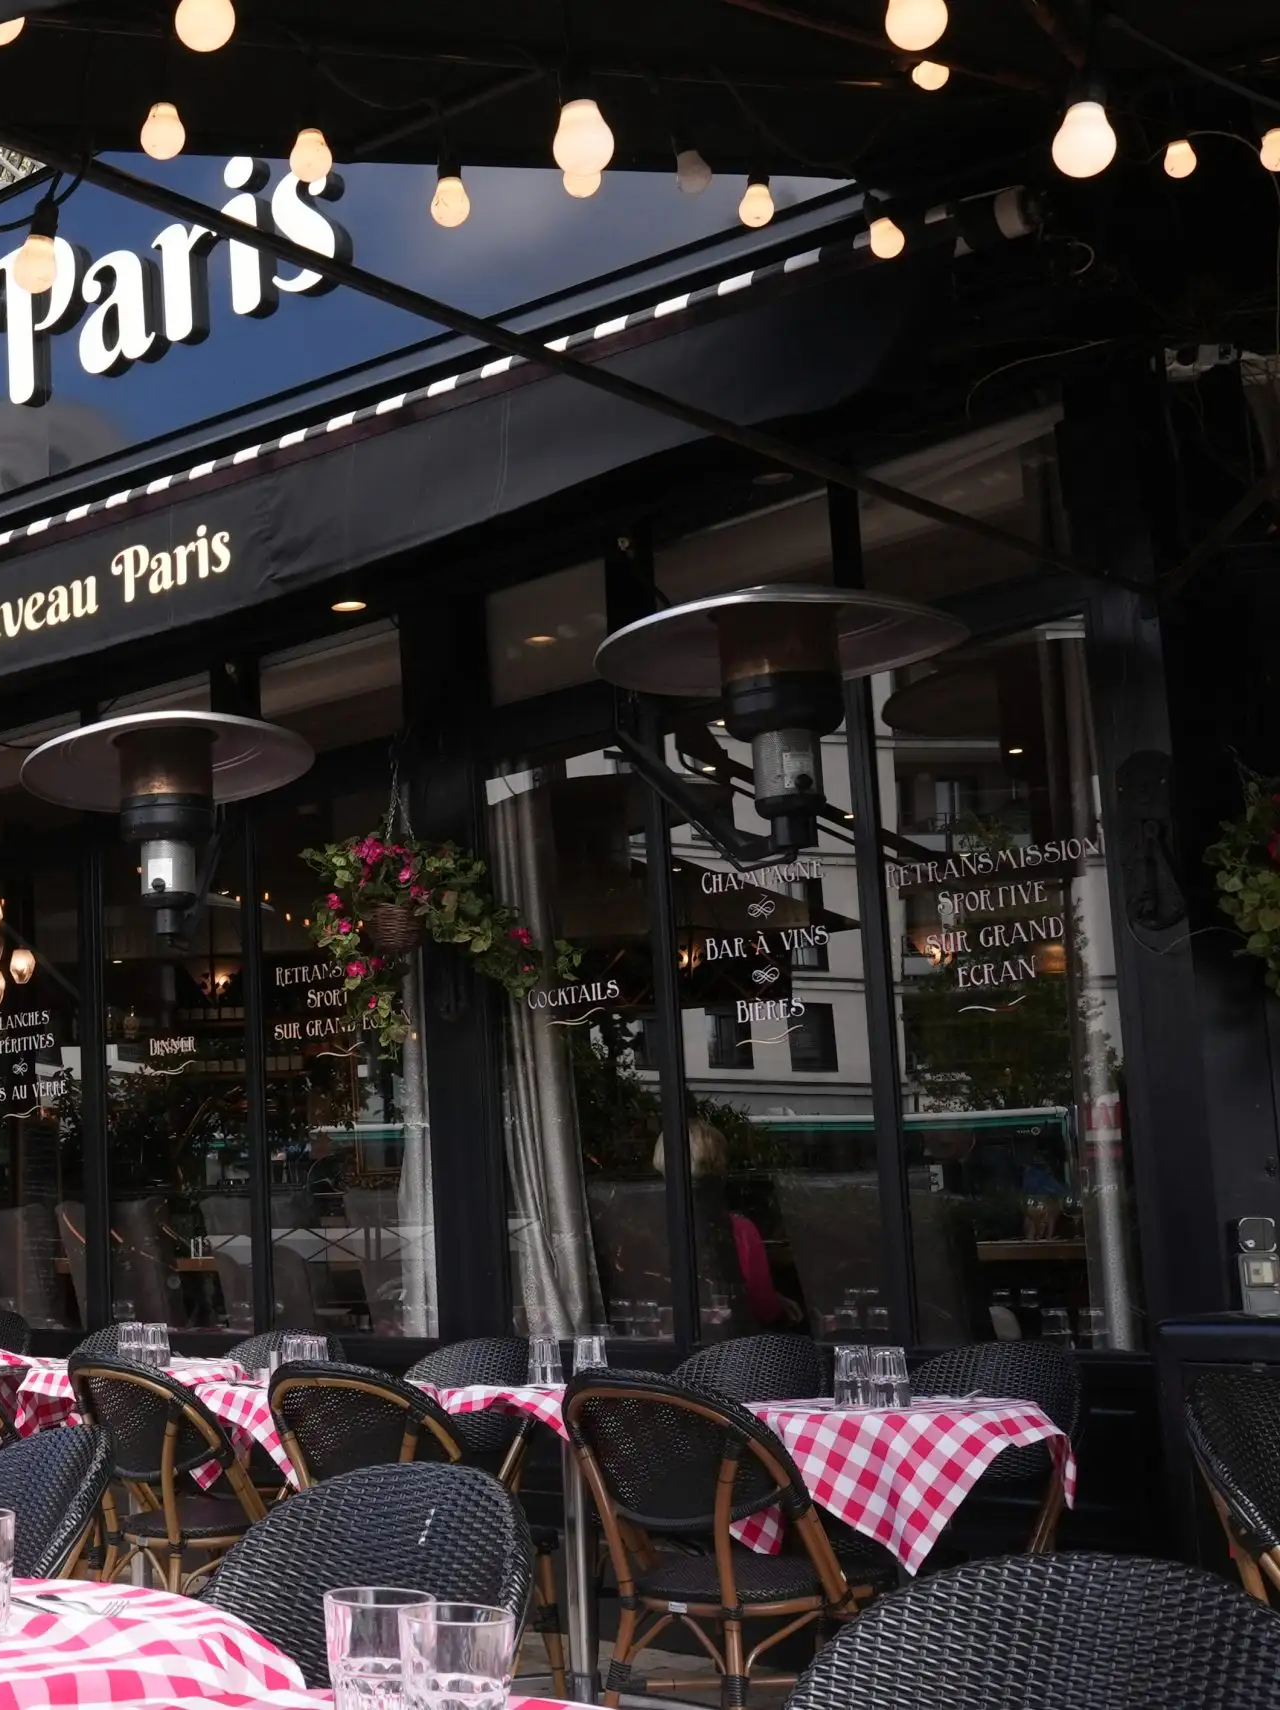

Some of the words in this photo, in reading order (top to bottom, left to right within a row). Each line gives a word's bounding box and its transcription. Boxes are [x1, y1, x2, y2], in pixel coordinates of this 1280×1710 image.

[110, 523, 232, 603] Paris
[700, 860, 824, 895] CHAMPAGNE
[884, 836, 1102, 889] RETRANSMISSION
[936, 880, 1048, 917] SPORTIVE
[705, 936, 748, 961] BAR
[755, 930, 771, 956] À
[779, 924, 830, 951] VINS
[925, 928, 971, 955] SUR
[979, 916, 1065, 949] GRAND
[527, 979, 621, 1010] COCKTAILS
[735, 996, 806, 1024] BIÈRES
[273, 1021, 303, 1041] SUR
[11, 1083, 28, 1101] AU
[31, 1079, 68, 1098] VERRE
